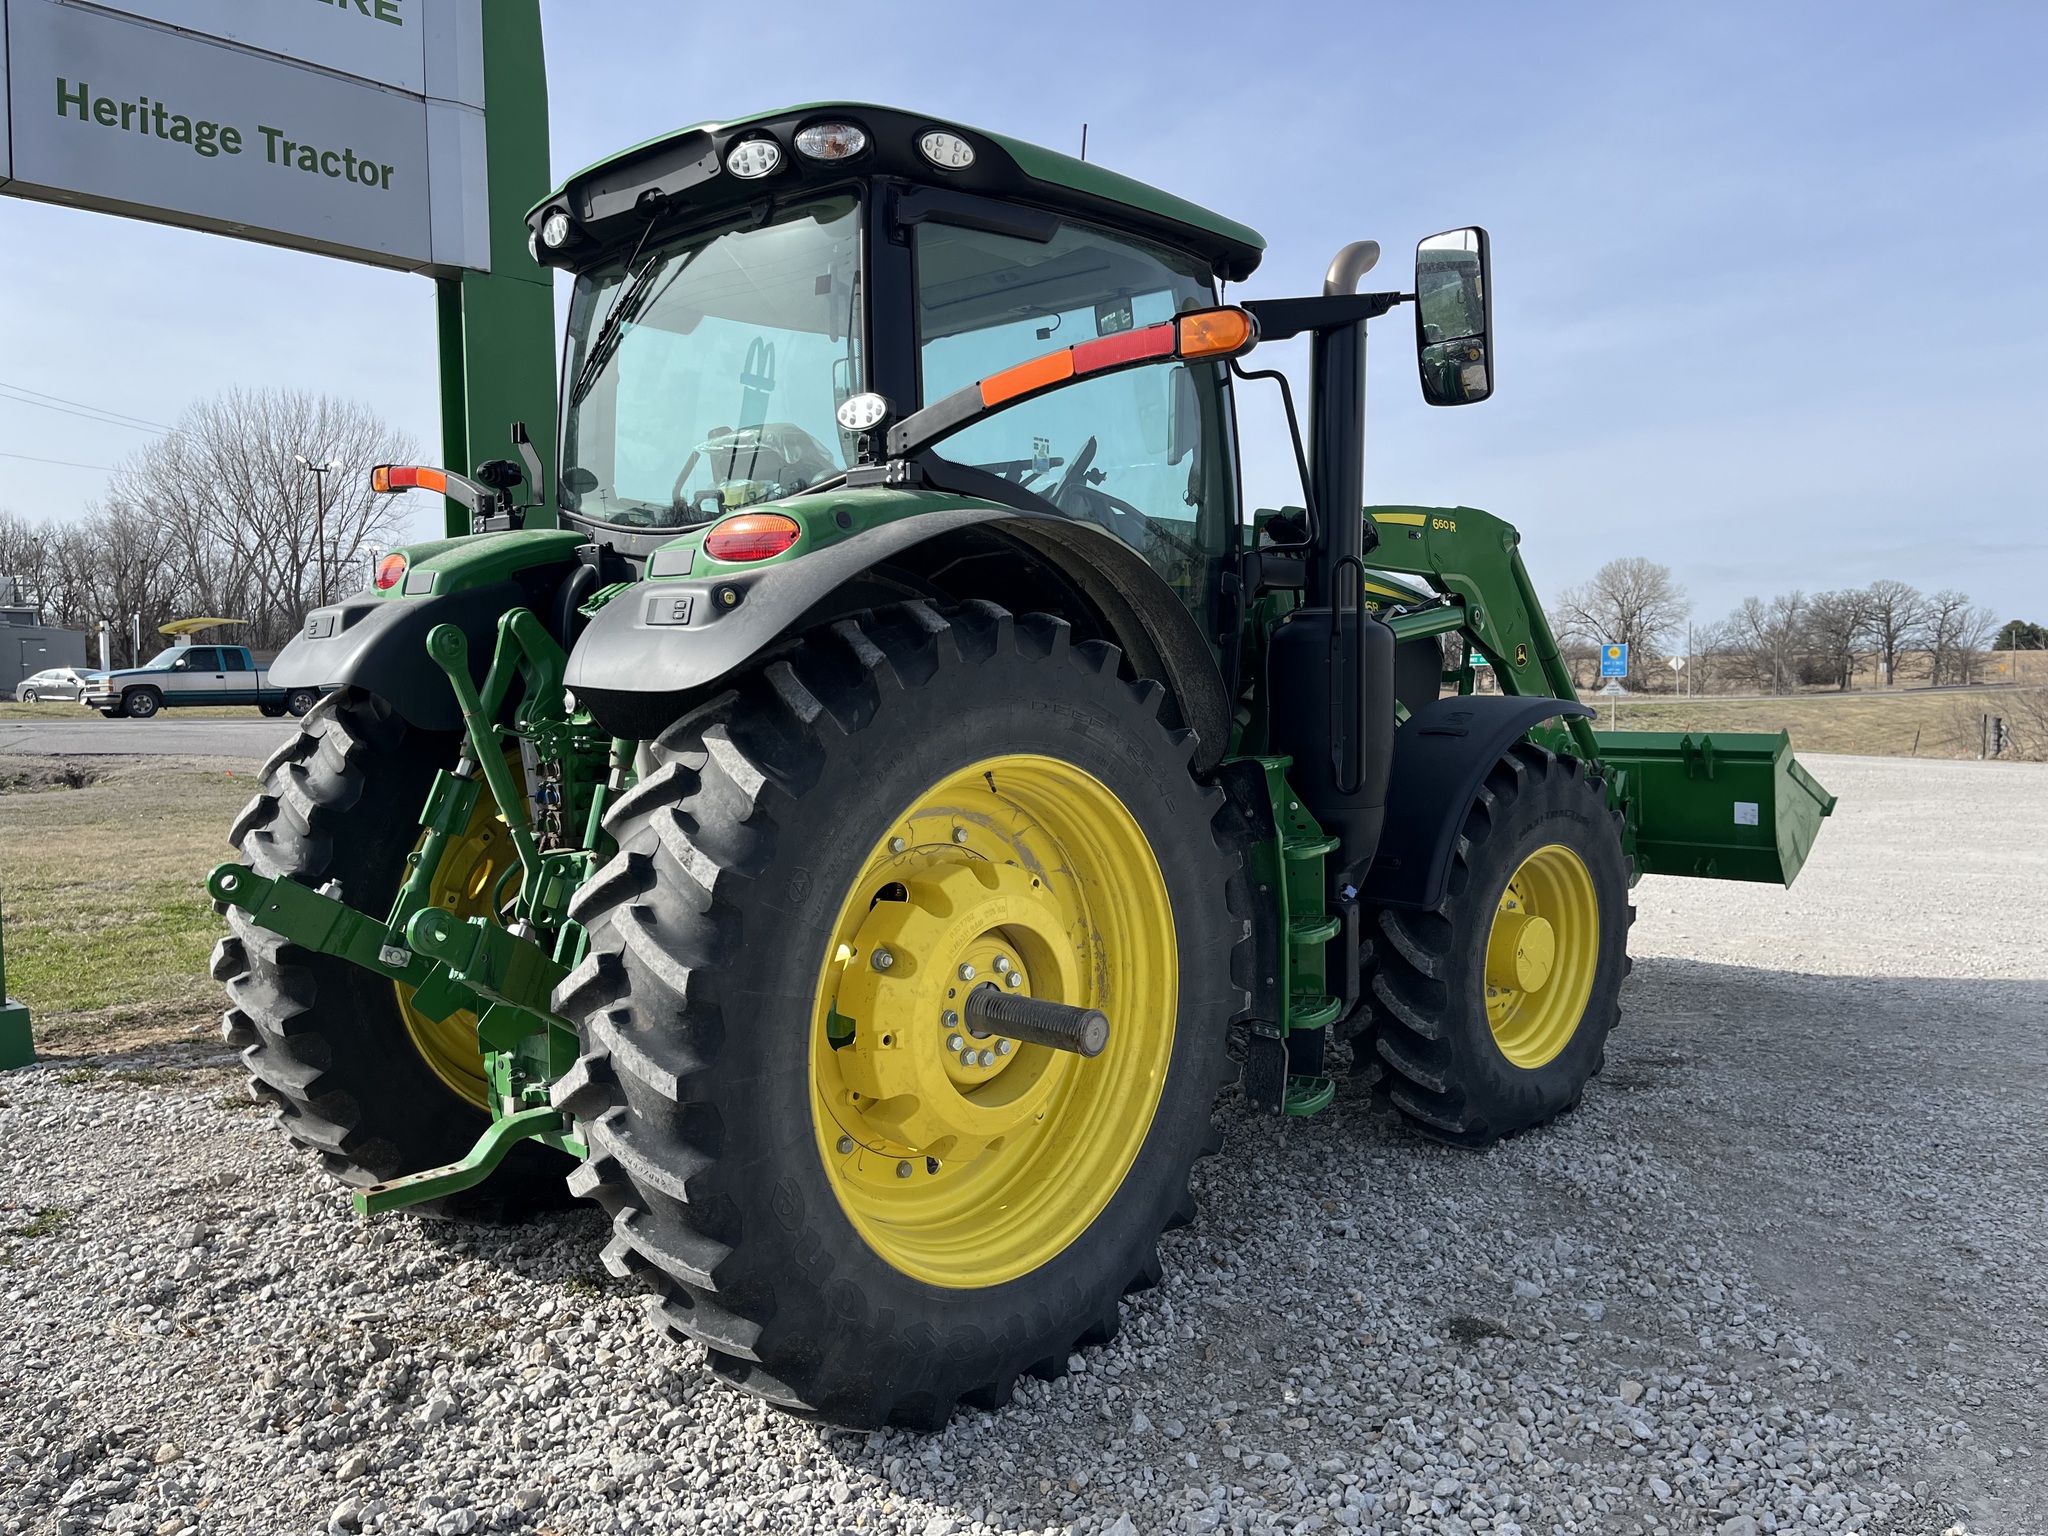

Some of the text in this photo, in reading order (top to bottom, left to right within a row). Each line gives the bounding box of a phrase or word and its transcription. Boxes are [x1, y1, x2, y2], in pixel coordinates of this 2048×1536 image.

[56, 77, 394, 190] Heritage Tractor
[1432, 518, 1457, 533] 660R
